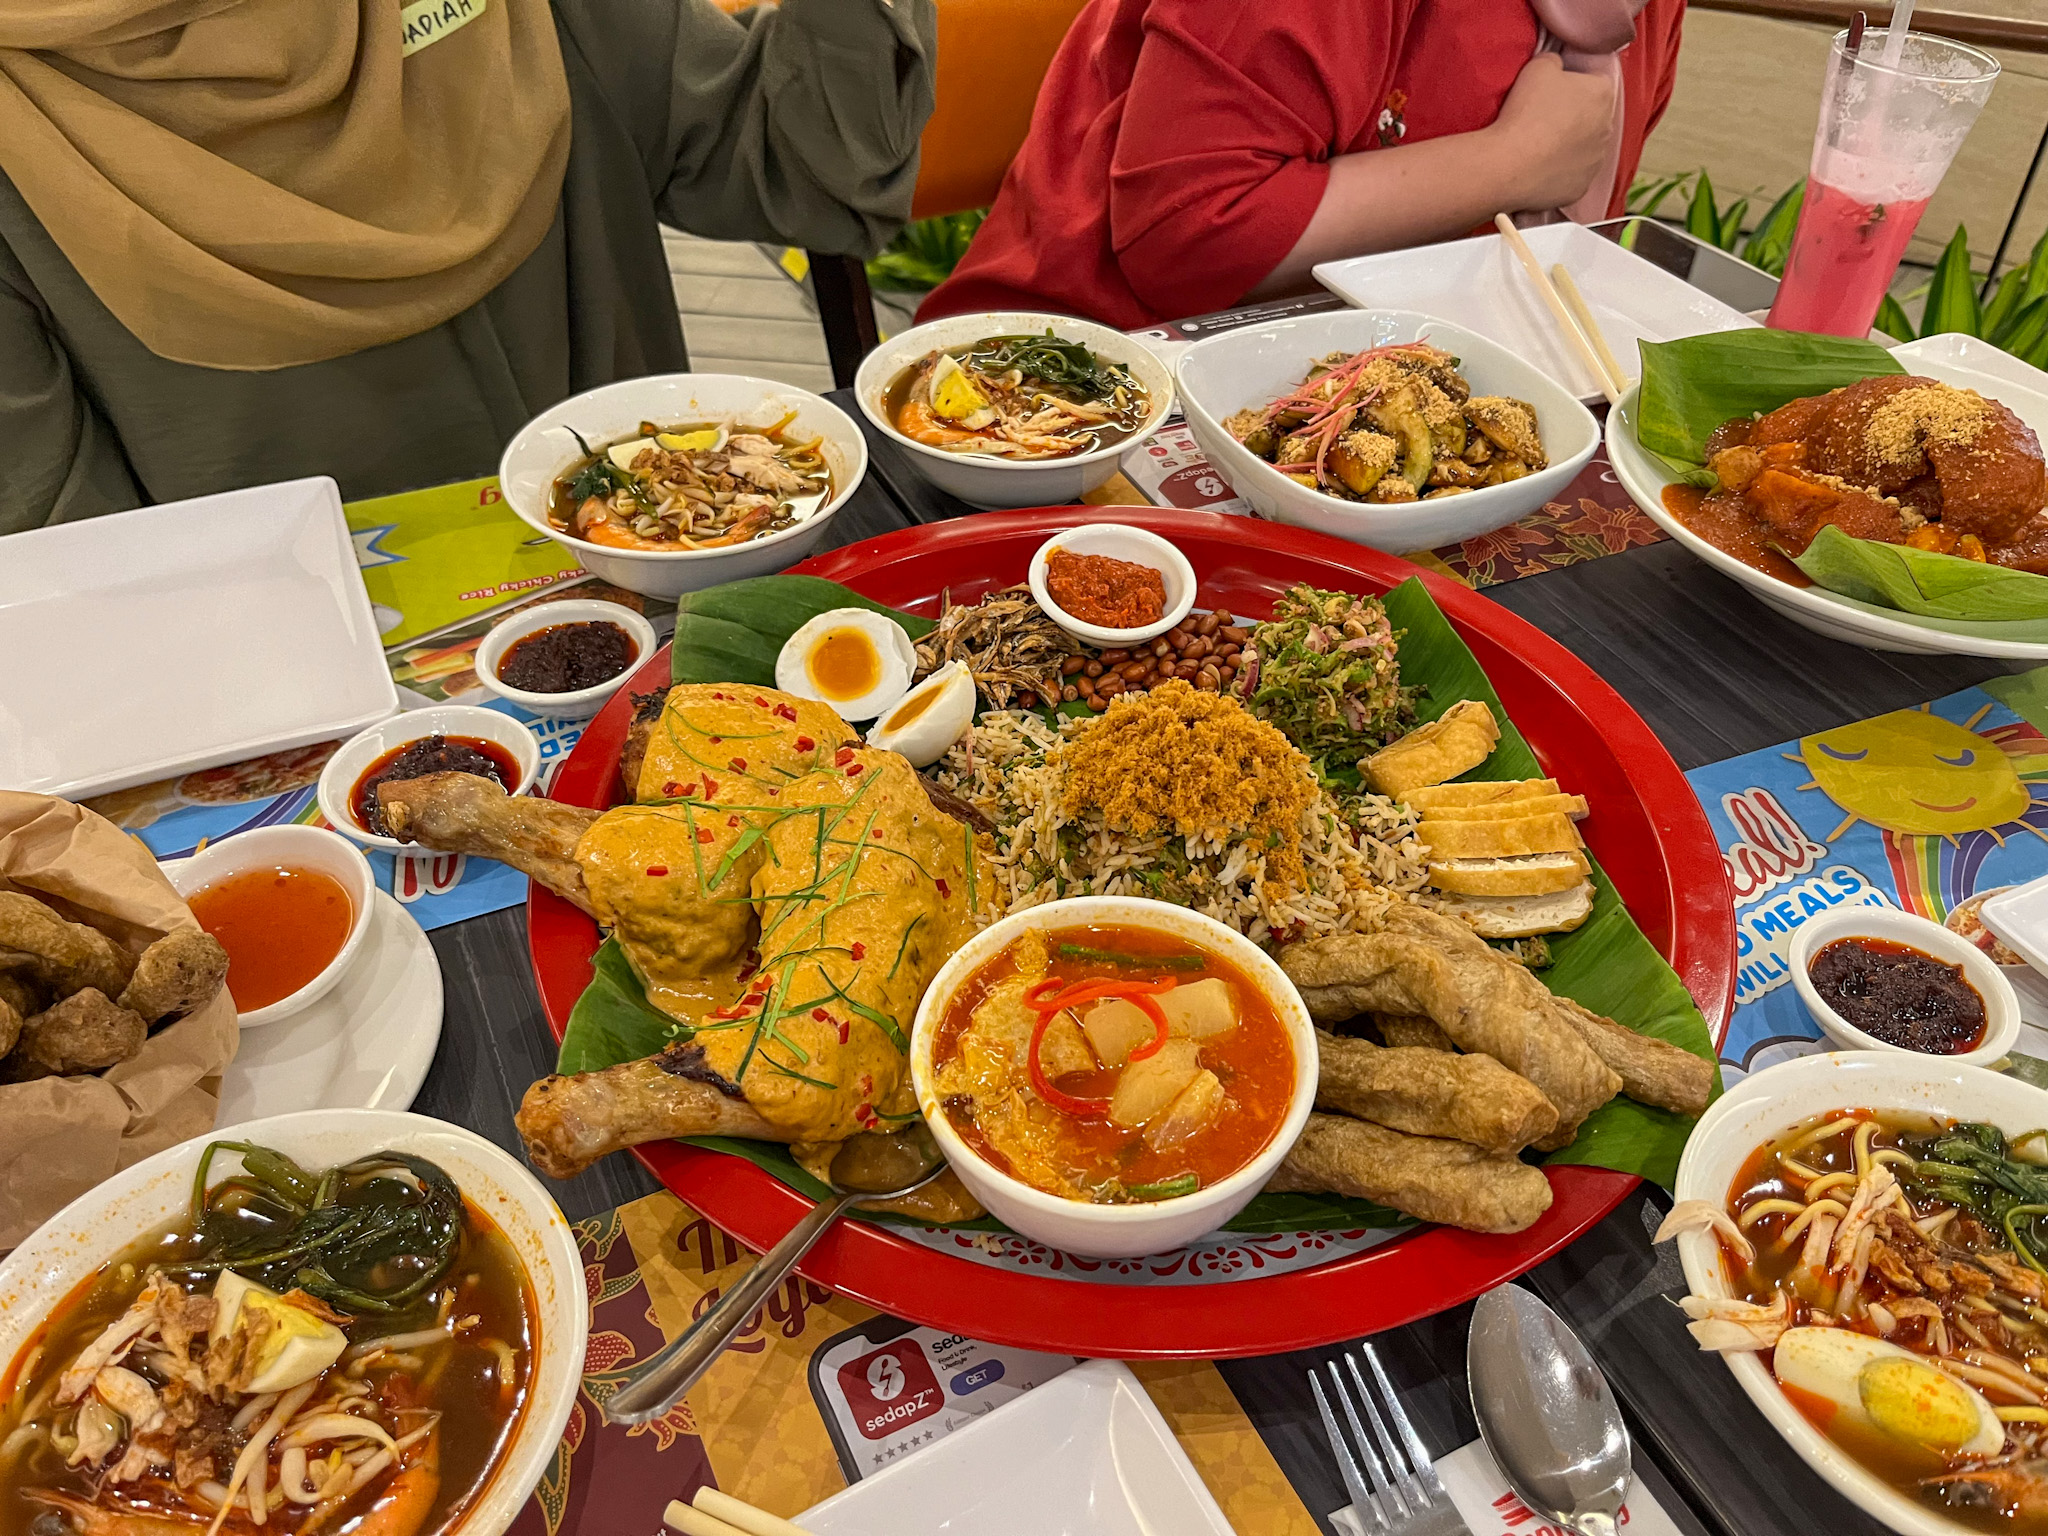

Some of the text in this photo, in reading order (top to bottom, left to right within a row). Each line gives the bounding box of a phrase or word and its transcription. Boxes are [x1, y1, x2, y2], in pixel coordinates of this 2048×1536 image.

[500, 575, 554, 592] Chicky
[459, 587, 497, 600] Rice
[1723, 791, 1818, 897] eal!
[1751, 870, 1861, 942] MEALS
[965, 1369, 988, 1385] GET
